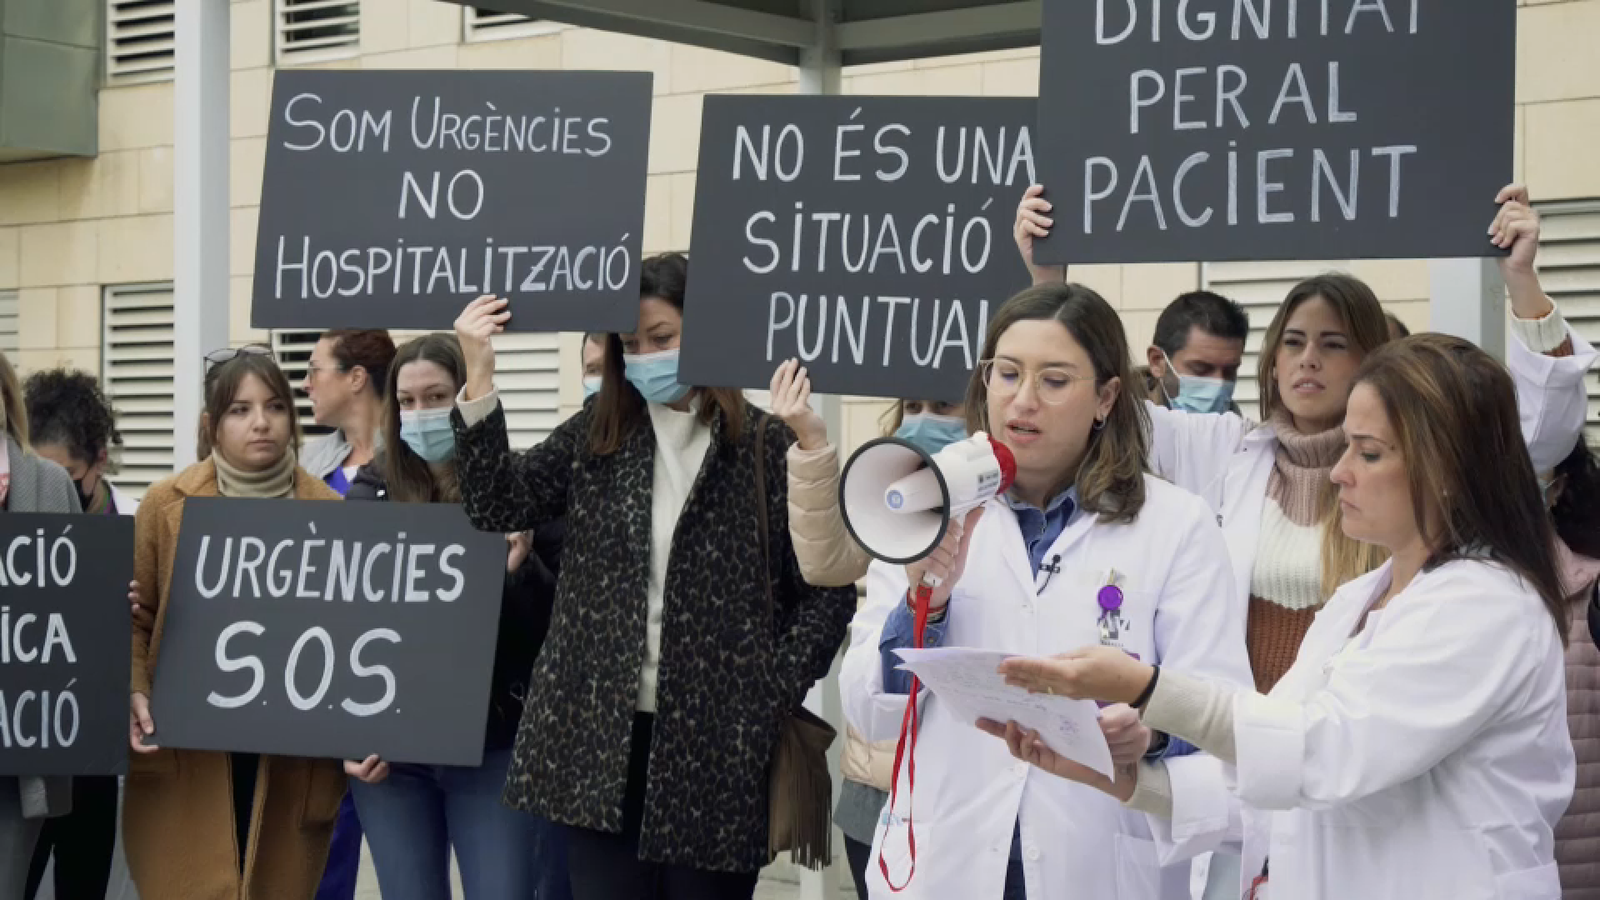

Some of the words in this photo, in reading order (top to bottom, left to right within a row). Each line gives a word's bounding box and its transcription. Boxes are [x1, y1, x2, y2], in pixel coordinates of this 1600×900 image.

[282, 92, 393, 153] SOM
[1129, 64, 1251, 135] PER
[1267, 61, 1358, 124] AL
[732, 123, 804, 183] NO
[833, 106, 912, 182] ÉS
[935, 125, 1037, 186] UNA
[397, 168, 485, 221] NO
[1083, 140, 1418, 235] PACIENT
[742, 197, 994, 276] SITUACIÓ
[194, 520, 466, 603] URGÈNCIES
[206, 620, 403, 718] S.O.S.
